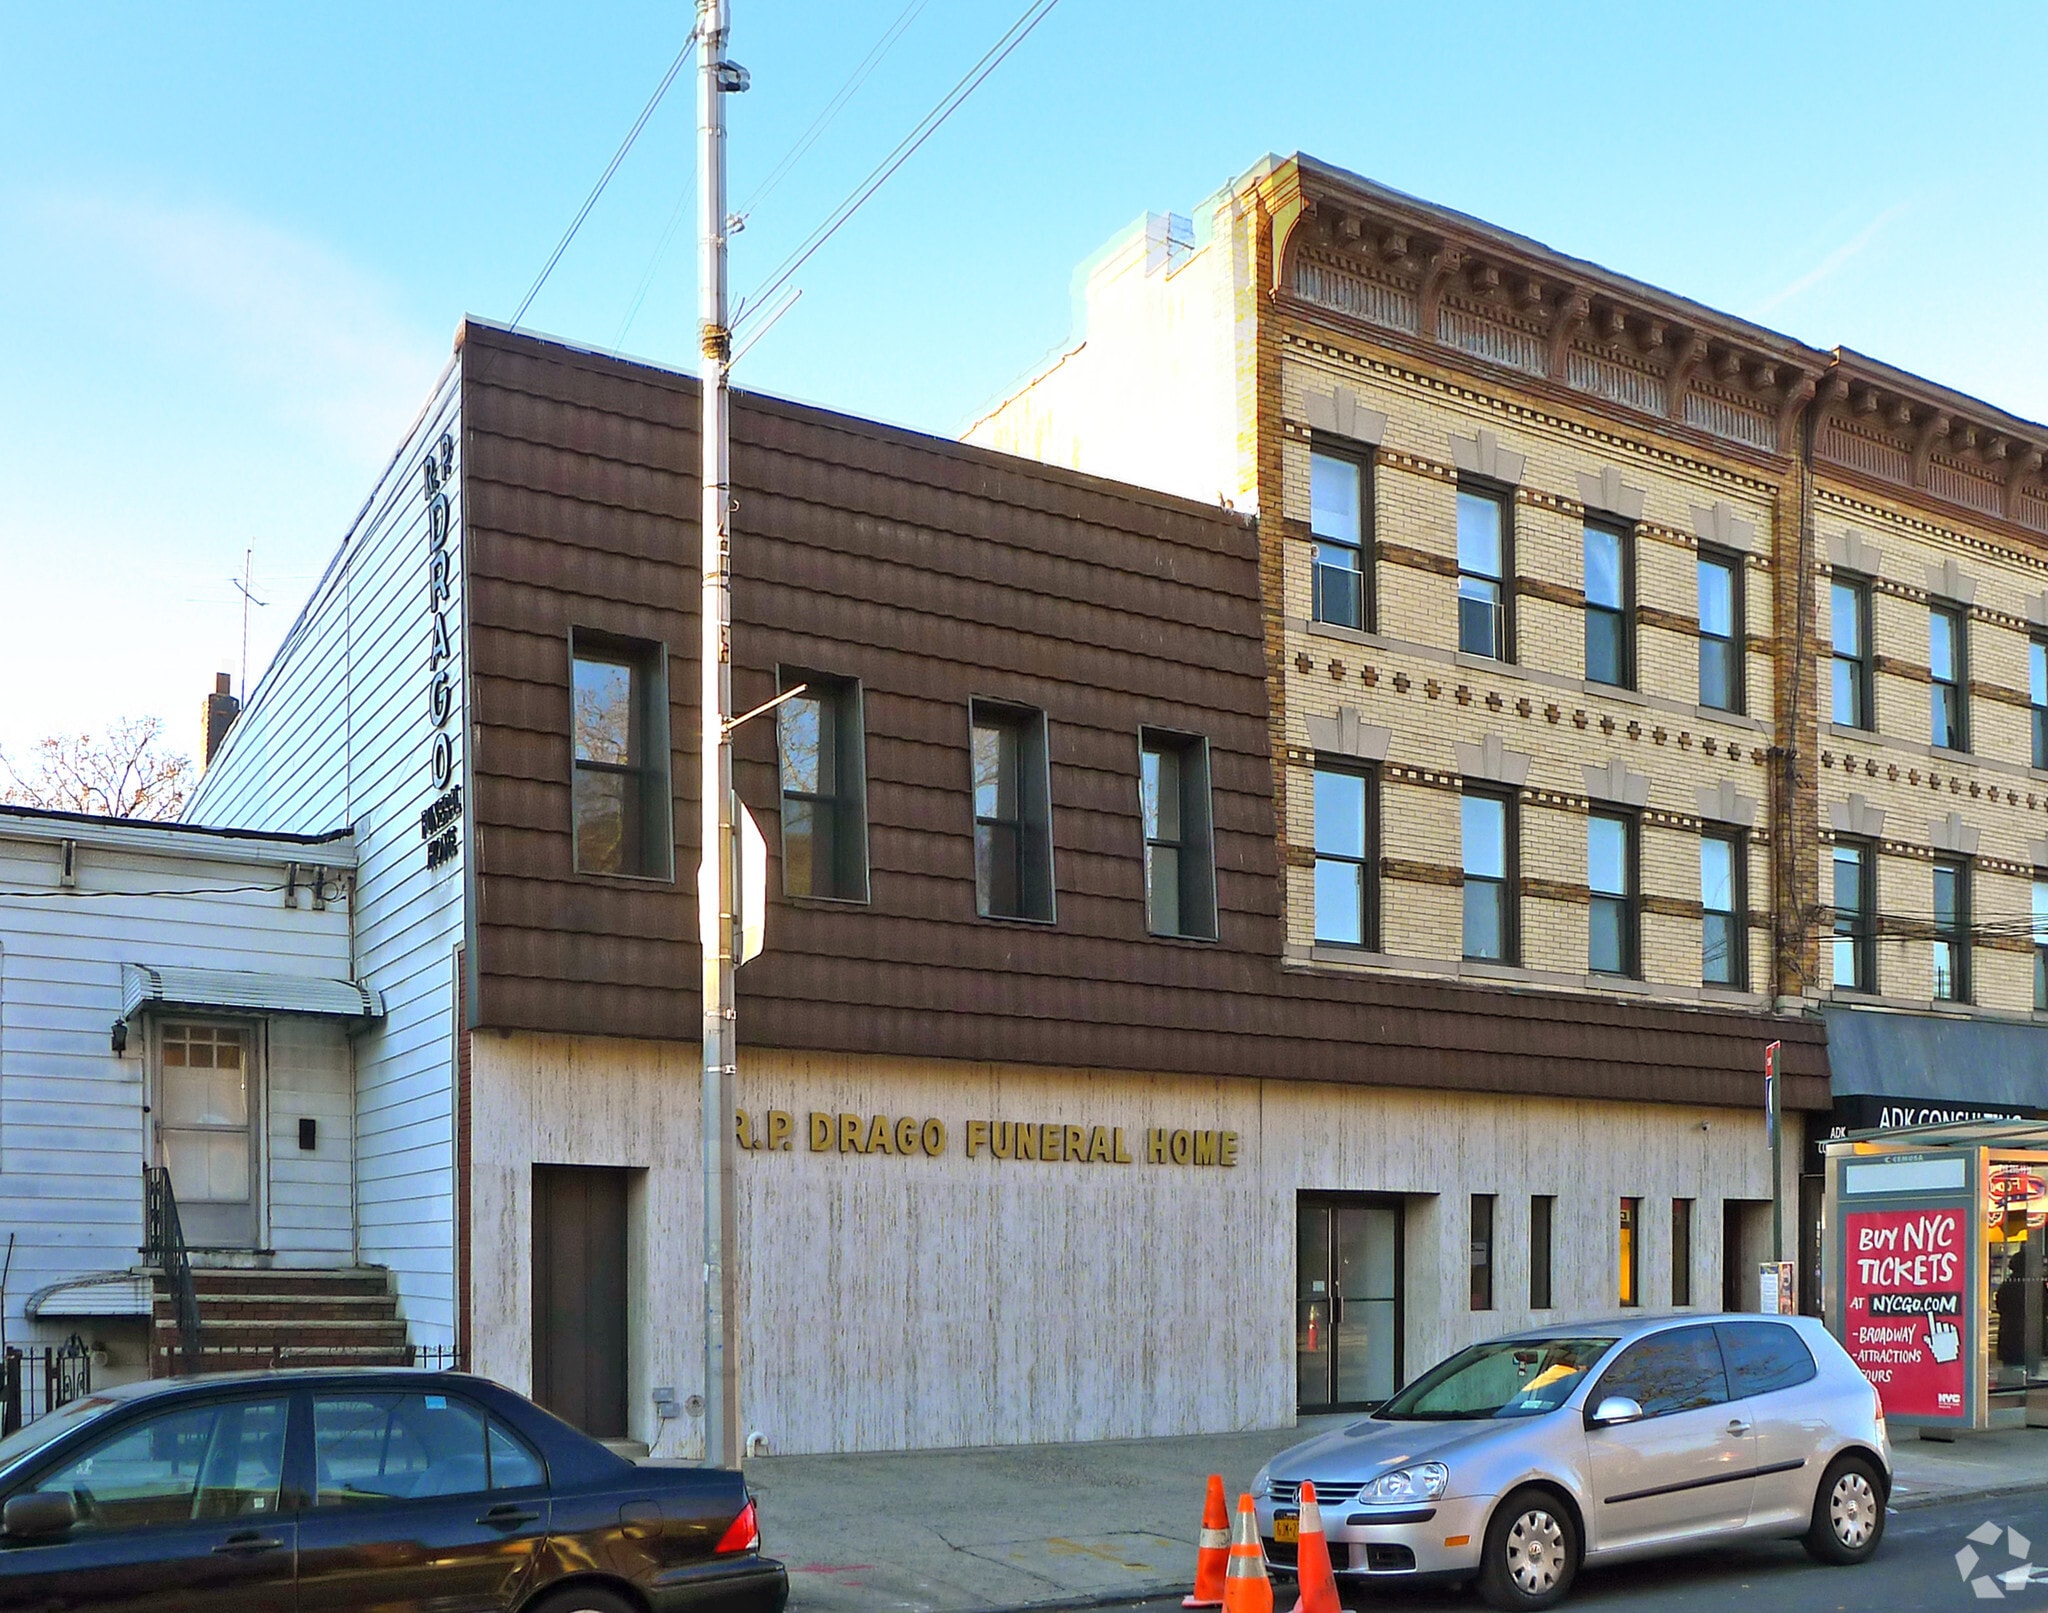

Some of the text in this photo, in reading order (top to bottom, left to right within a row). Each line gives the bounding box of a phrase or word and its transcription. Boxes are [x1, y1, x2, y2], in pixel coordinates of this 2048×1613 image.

[429, 492, 452, 790] DRAGO
[1830, 1126, 1847, 1139] ADK
[1880, 1106, 1915, 1128] ADK
[809, 1111, 946, 1157] DRAGO
[966, 1120, 1132, 1164] FUNERAL
[1147, 1127, 1238, 1167] HOME
[1859, 1215, 1955, 1252] BUY NYC
[1857, 1252, 1958, 1286] TICKETS
[1849, 1295, 1957, 1313] AT NYCGO.COM
